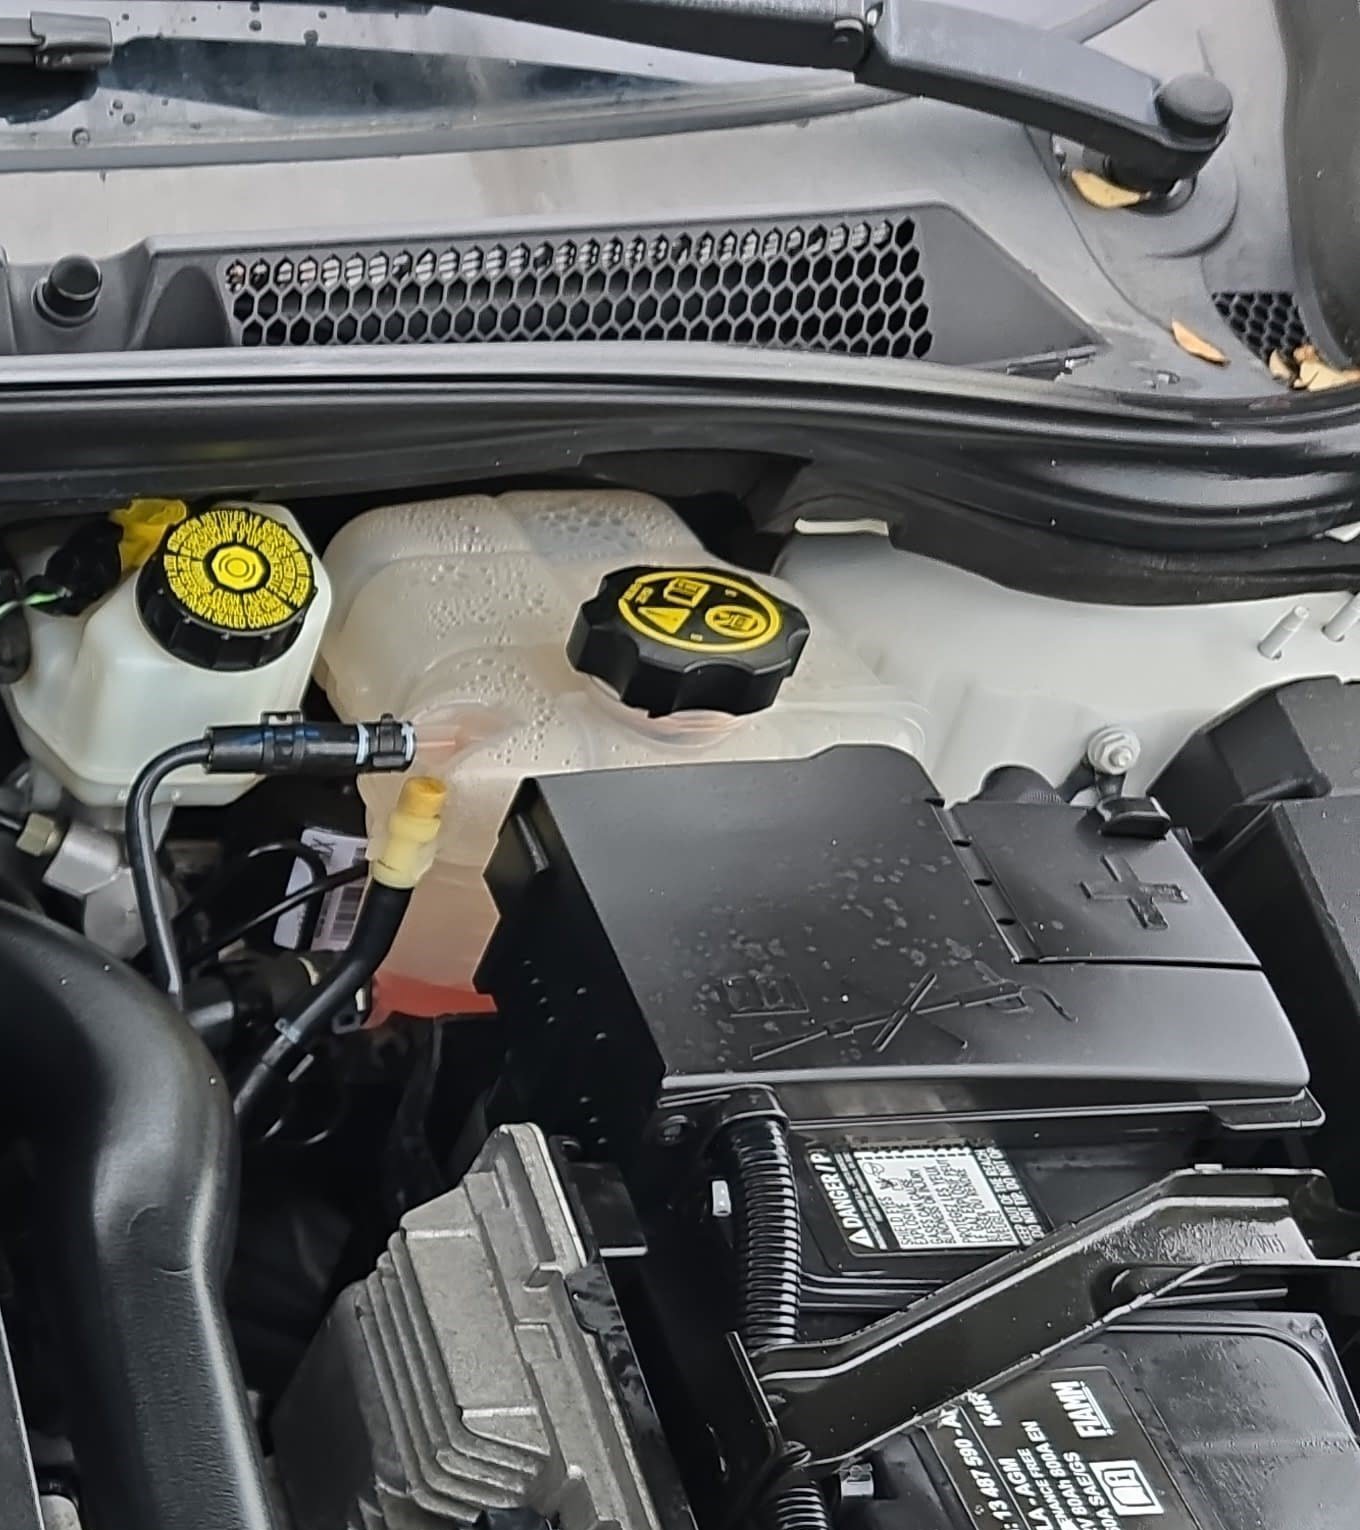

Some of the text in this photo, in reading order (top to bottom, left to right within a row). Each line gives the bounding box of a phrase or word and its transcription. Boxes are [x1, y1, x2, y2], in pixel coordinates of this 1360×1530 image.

[1051, 1381, 1108, 1438] FIAMM
[1021, 1420, 1047, 1442] EN
[954, 1438, 984, 1467] 590
[1017, 1448, 1039, 1479] FREE
[1035, 1442, 1066, 1478] 800A
[970, 1469, 999, 1499] 487
[1063, 1451, 1106, 1507] SAE/GS
[987, 1499, 1013, 1521] 13
[1057, 1480, 1088, 1517] 80Ah
